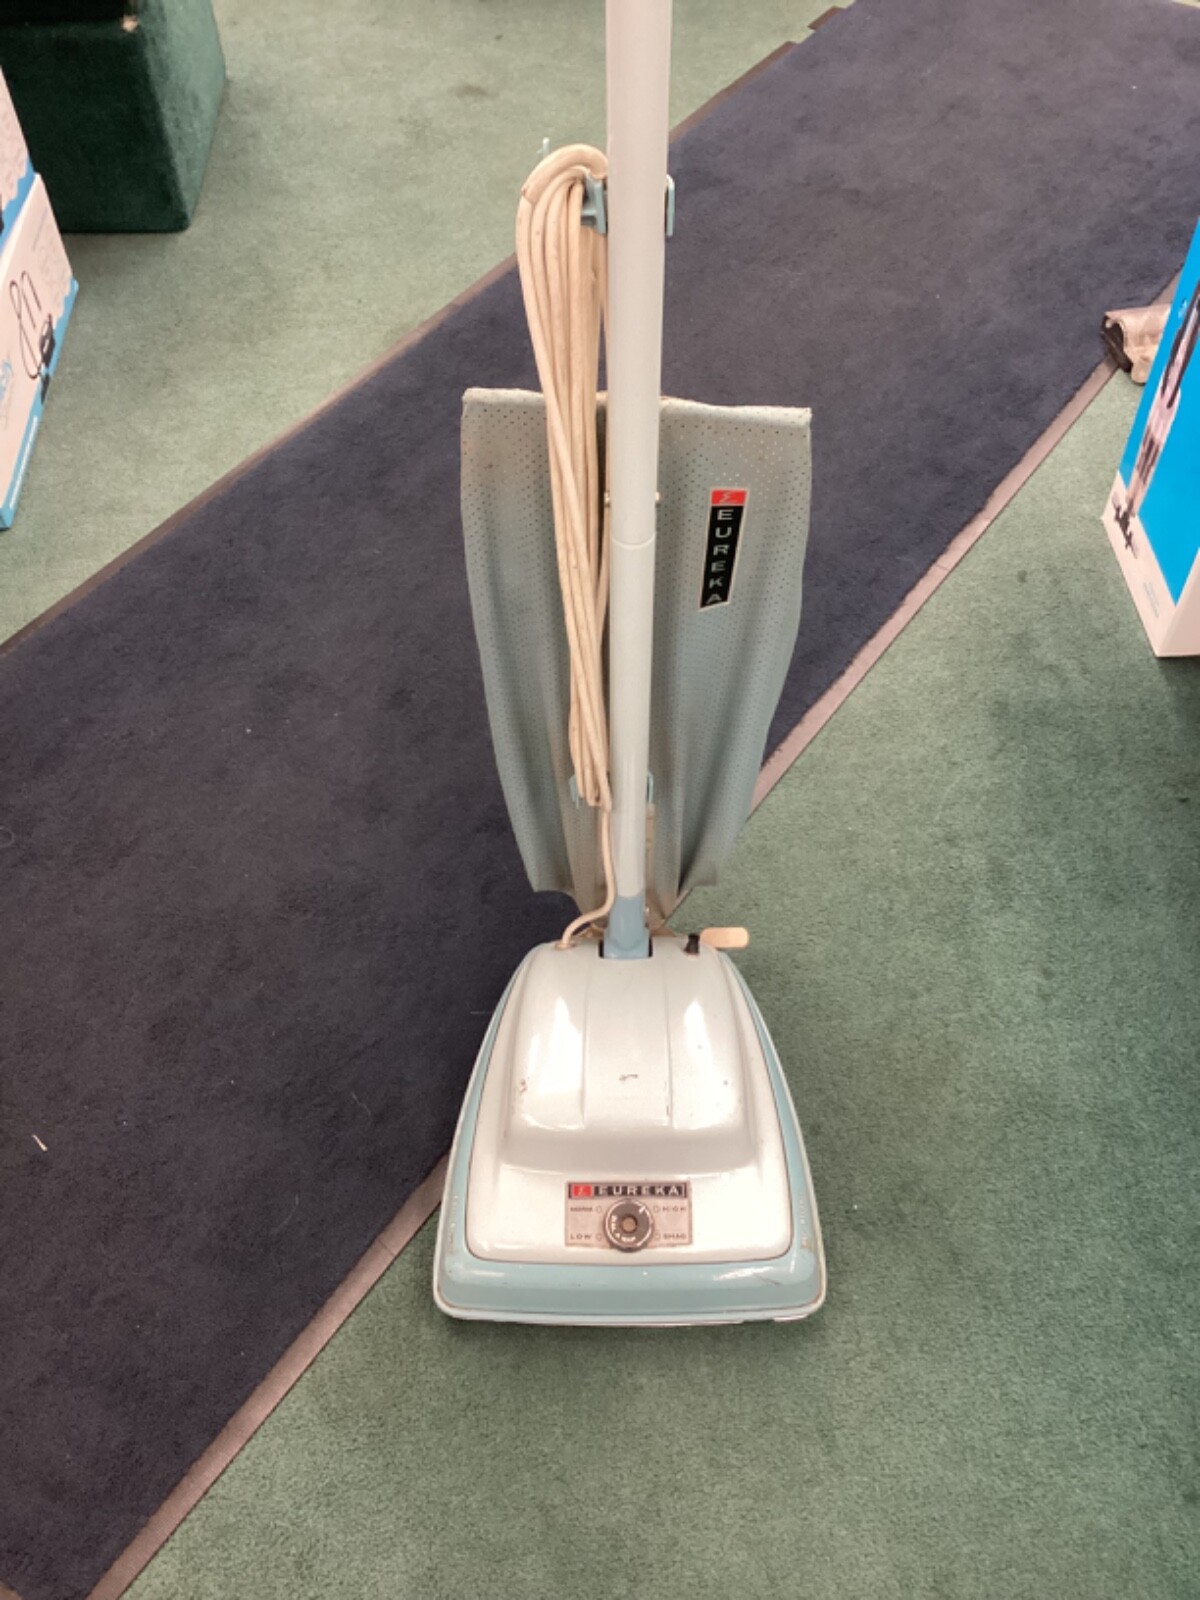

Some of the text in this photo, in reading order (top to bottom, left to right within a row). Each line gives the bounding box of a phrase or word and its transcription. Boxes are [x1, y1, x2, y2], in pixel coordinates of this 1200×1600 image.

[706, 509, 734, 605] EUREKA
[598, 1185, 680, 1197] EUREKA
[662, 1205, 687, 1213] HGH
[570, 1232, 592, 1240] LOW
